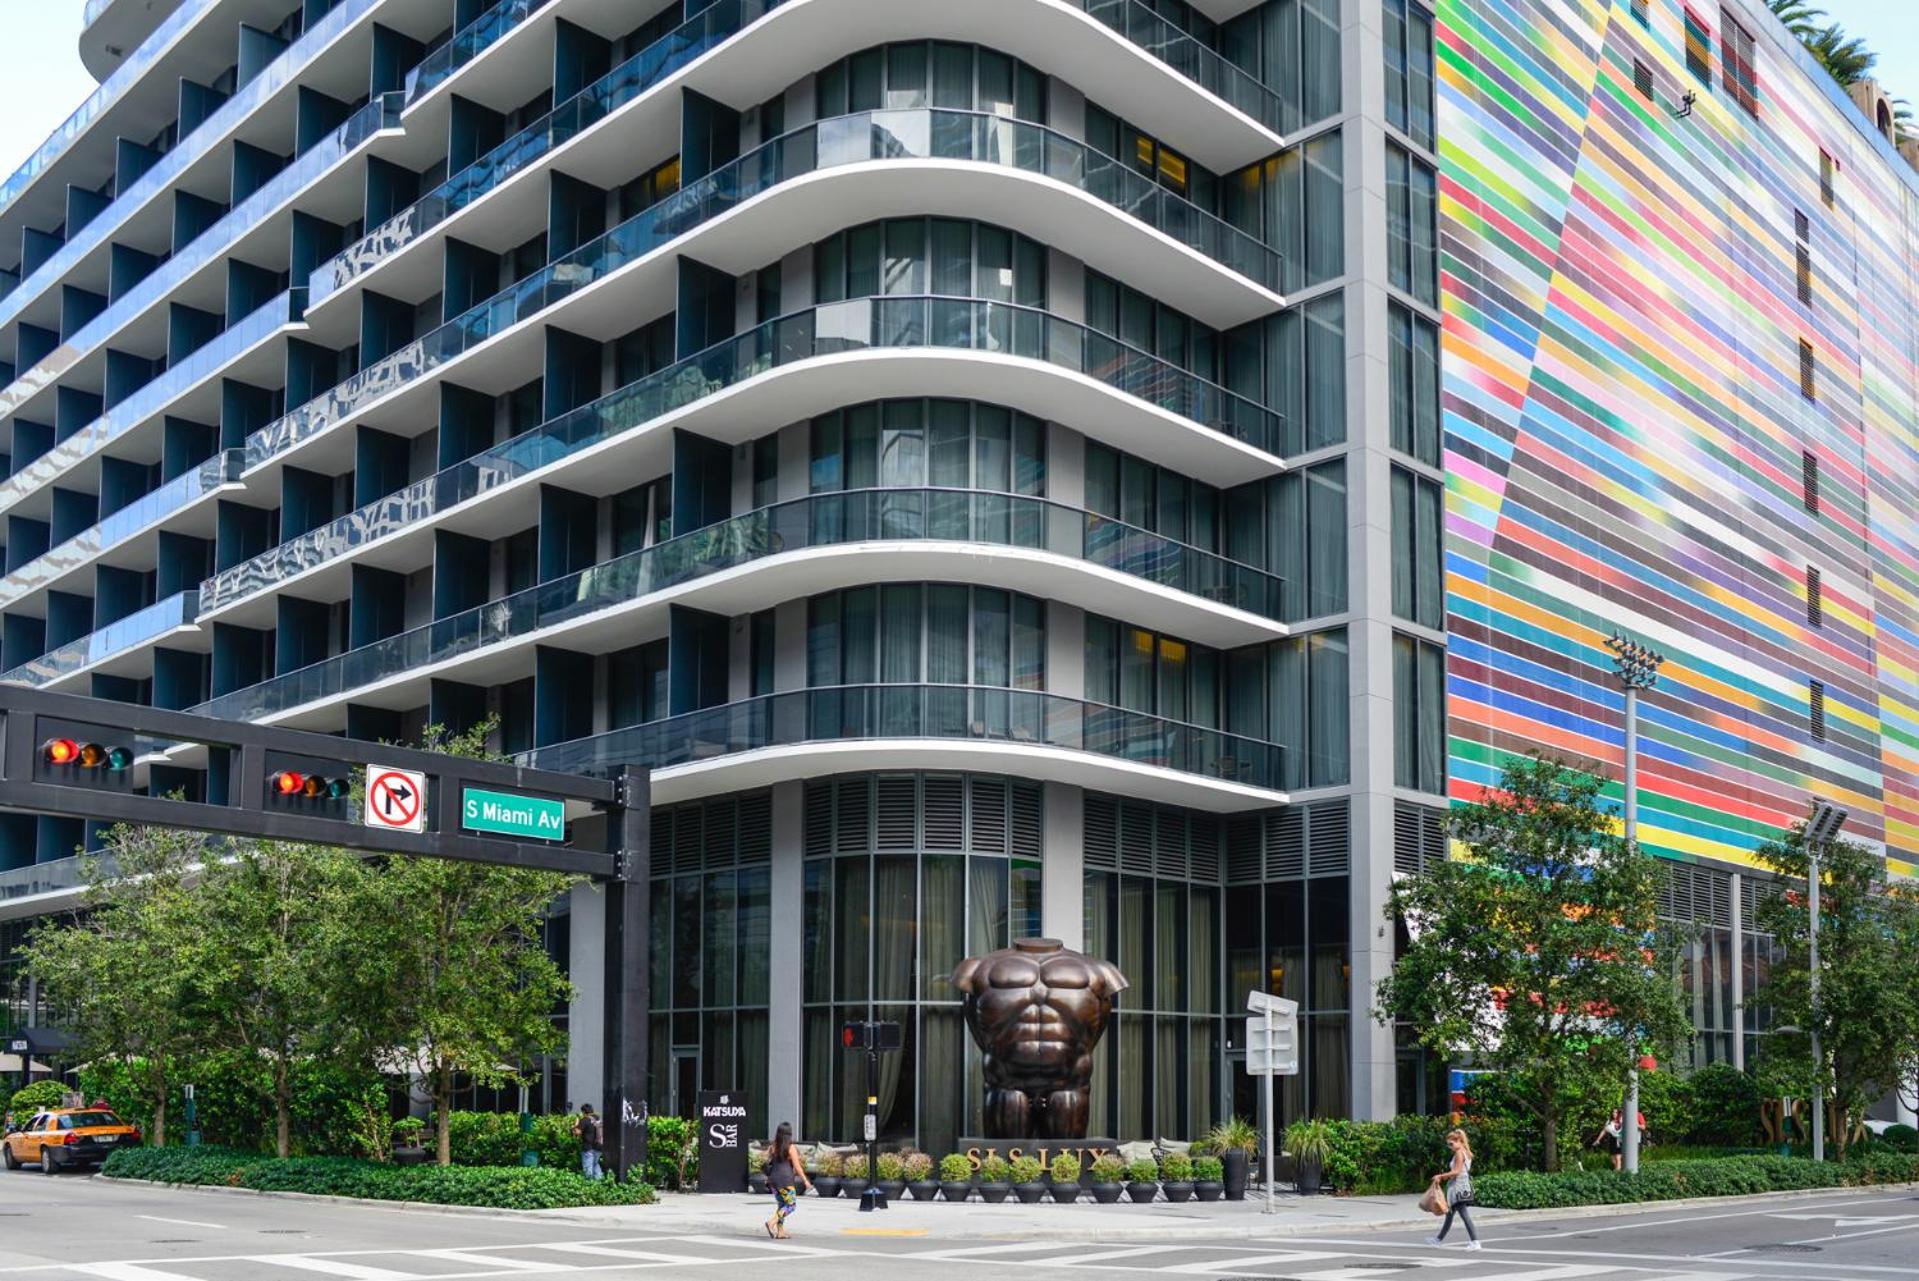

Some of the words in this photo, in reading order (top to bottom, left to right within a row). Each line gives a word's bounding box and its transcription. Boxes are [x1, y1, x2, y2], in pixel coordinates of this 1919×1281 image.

[466, 799, 478, 819] S
[483, 801, 533, 826] Miami
[538, 810, 561, 829] Av
[703, 1106, 747, 1117] KATSUYA
[726, 1124, 738, 1148] BAR
